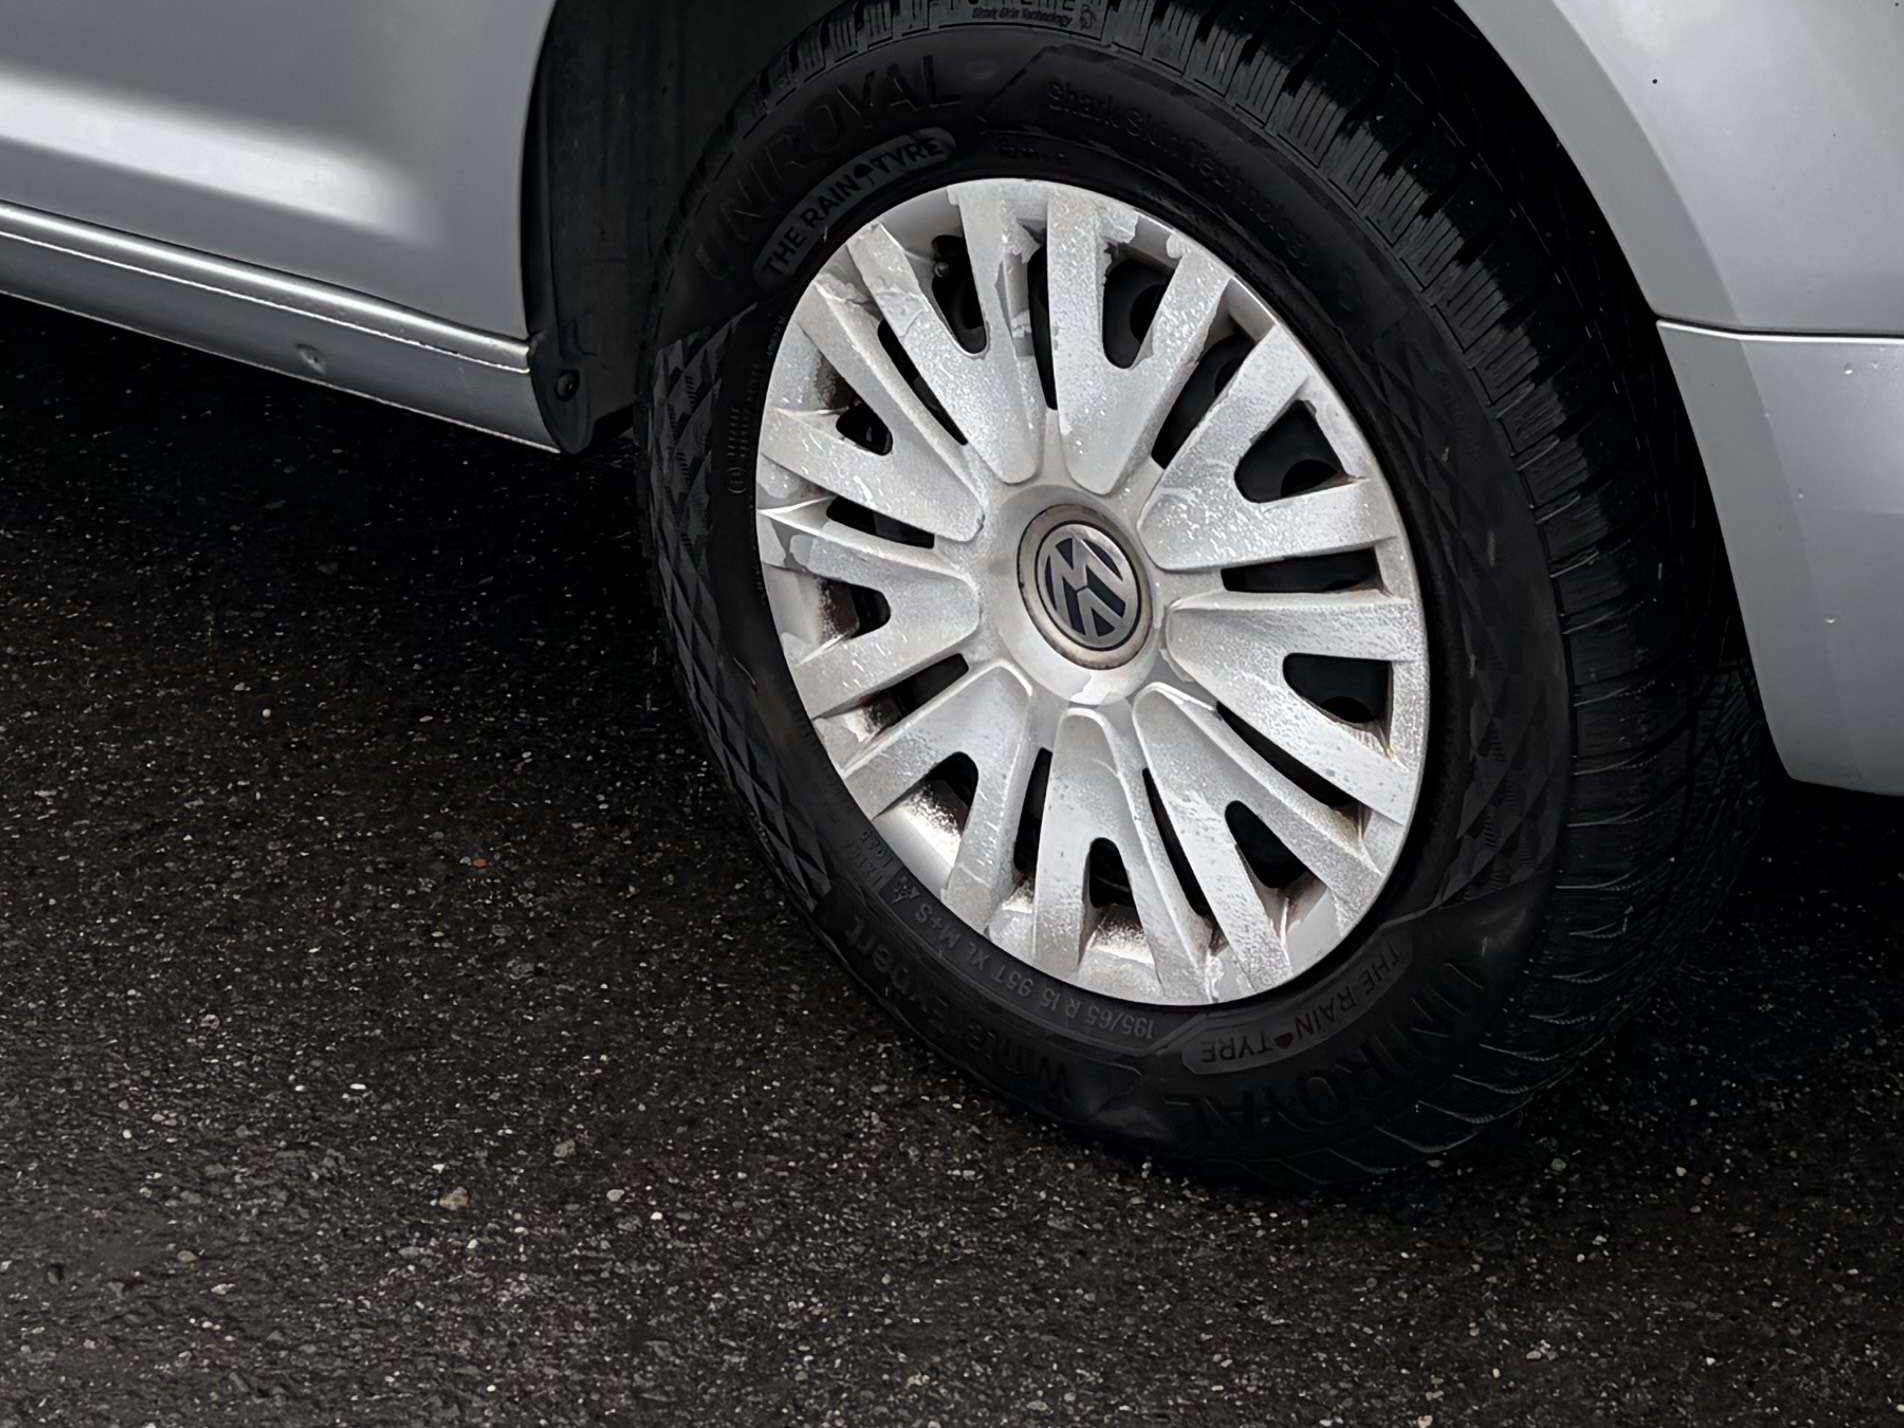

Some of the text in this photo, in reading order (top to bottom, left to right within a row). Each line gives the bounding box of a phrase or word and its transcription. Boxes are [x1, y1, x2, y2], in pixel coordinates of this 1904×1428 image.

[761, 137, 946, 277] THE RAIN TYRE
[914, 903, 962, 950] M+S
[965, 946, 992, 972] XL
[1039, 988, 1058, 1009] 15
[1087, 1000, 1155, 1040] 195/65
[1199, 943, 1403, 1064] THE RAIN TYRE
